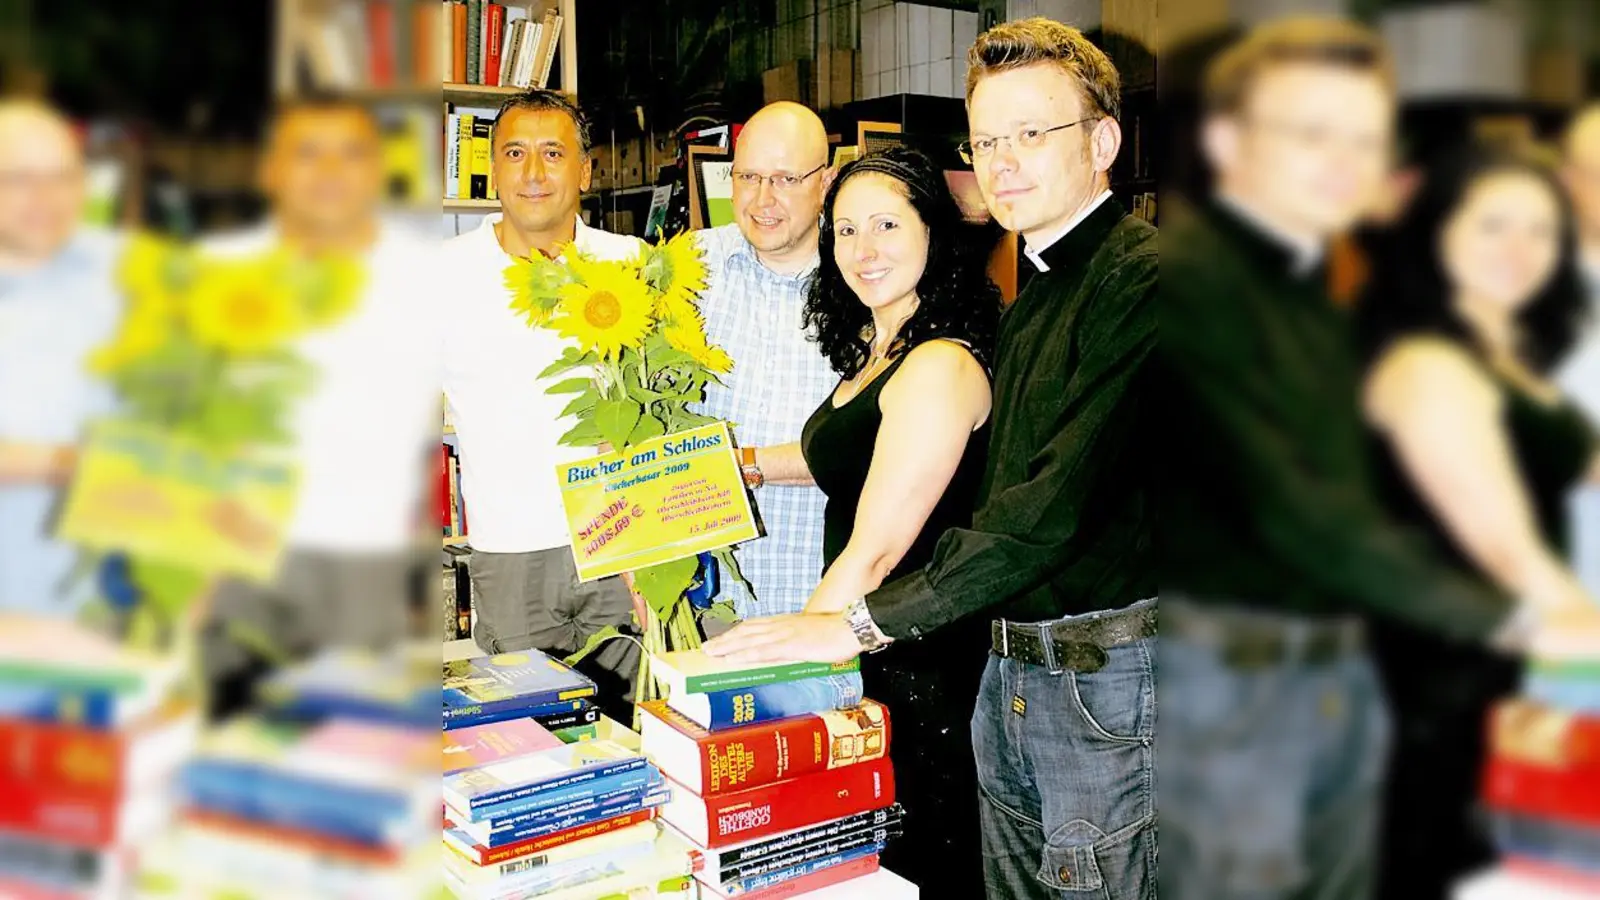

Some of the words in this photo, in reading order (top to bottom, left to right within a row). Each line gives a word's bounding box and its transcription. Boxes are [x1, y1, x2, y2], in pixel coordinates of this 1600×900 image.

[567, 457, 625, 483] Bücher
[631, 450, 656, 466] am
[663, 432, 721, 456] Schloss
[664, 462, 690, 475] 2009
[578, 496, 628, 540] SPENDE
[631, 504, 645, 519] €
[702, 520, 718, 530] Juli
[719, 514, 742, 525] 2009
[744, 692, 756, 722] 2010
[706, 743, 720, 791] LEXIKON
[718, 755, 728, 777] DES
[728, 742, 738, 786] MITTEL
[737, 742, 746, 782] ALTERS
[745, 750, 755, 772] VIII
[838, 789, 848, 798] 3
[718, 804, 770, 824] HANDBUCH
[719, 813, 771, 835] GOETHE
